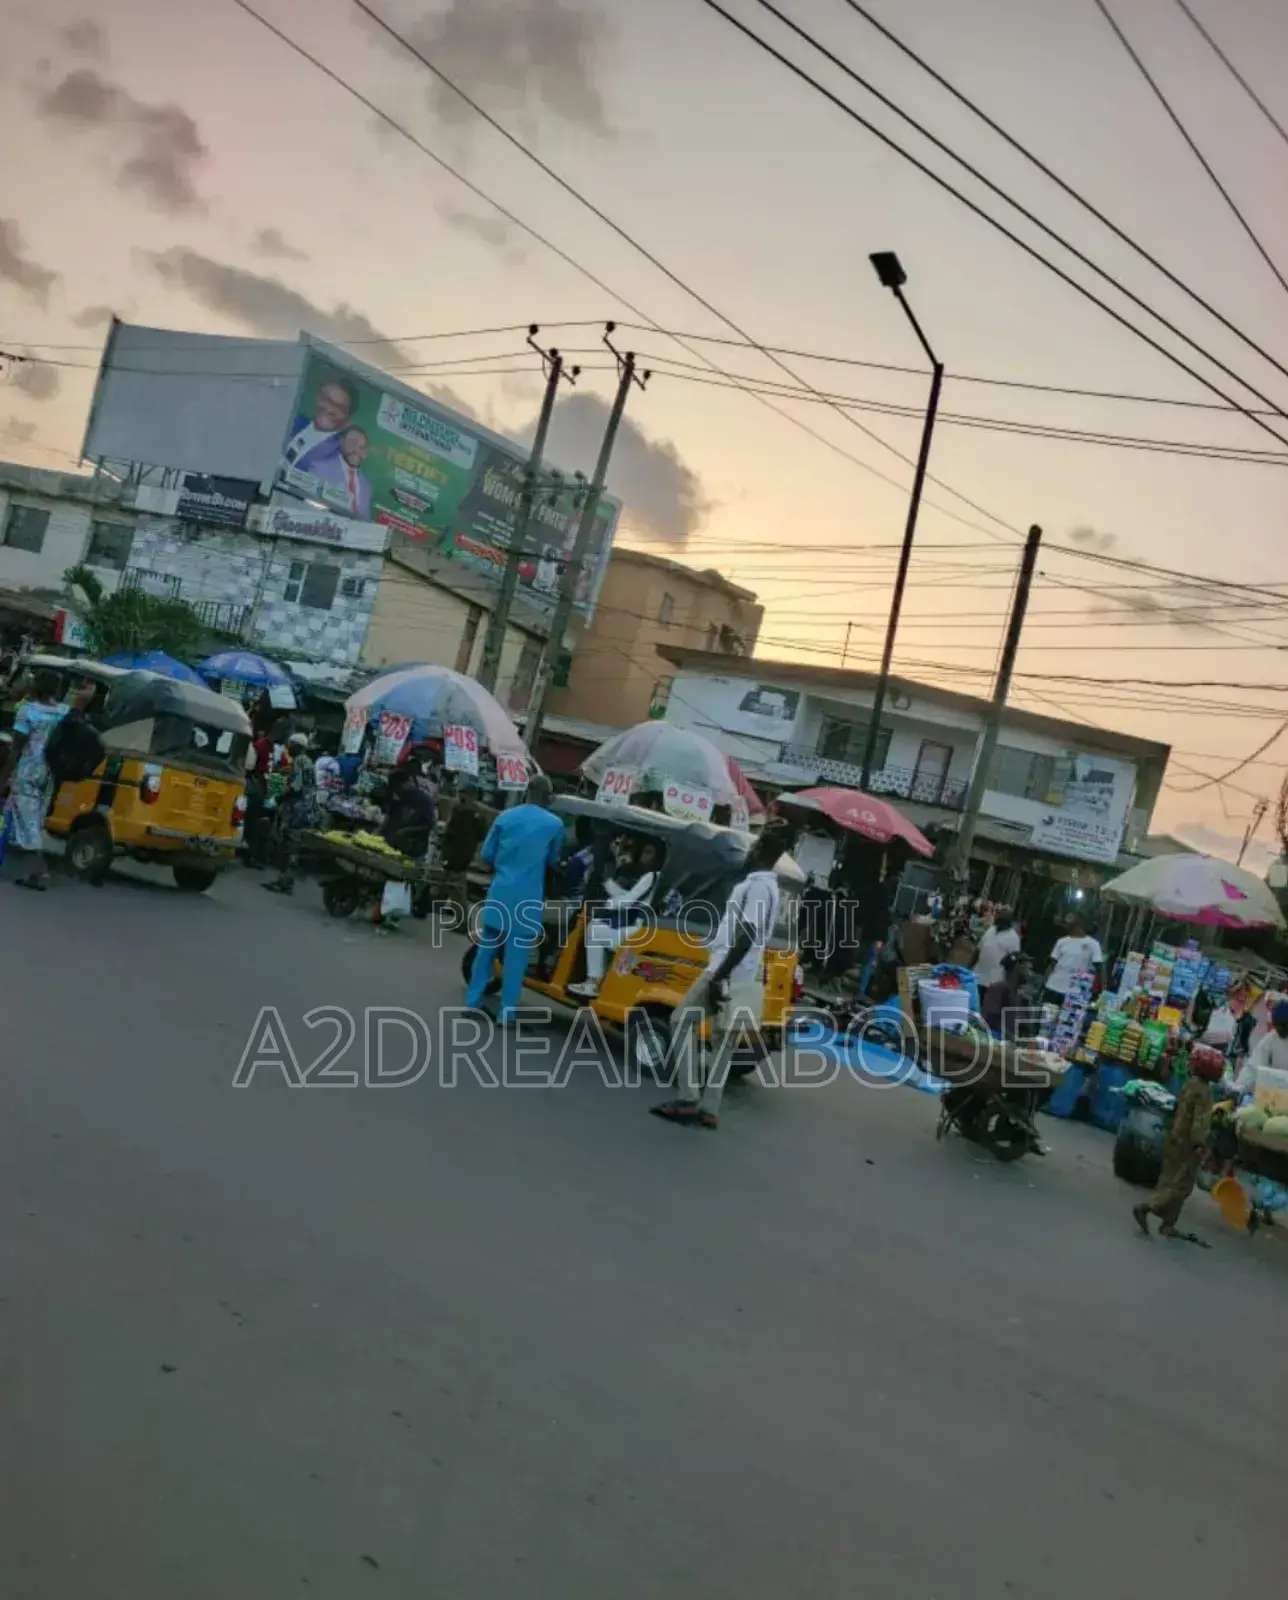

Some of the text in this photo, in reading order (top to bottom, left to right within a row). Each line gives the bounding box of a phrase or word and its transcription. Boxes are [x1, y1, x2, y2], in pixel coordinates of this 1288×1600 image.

[380, 711, 411, 741] POS
[446, 722, 476, 751] POS
[497, 757, 528, 783] POS
[603, 770, 632, 794] POS
